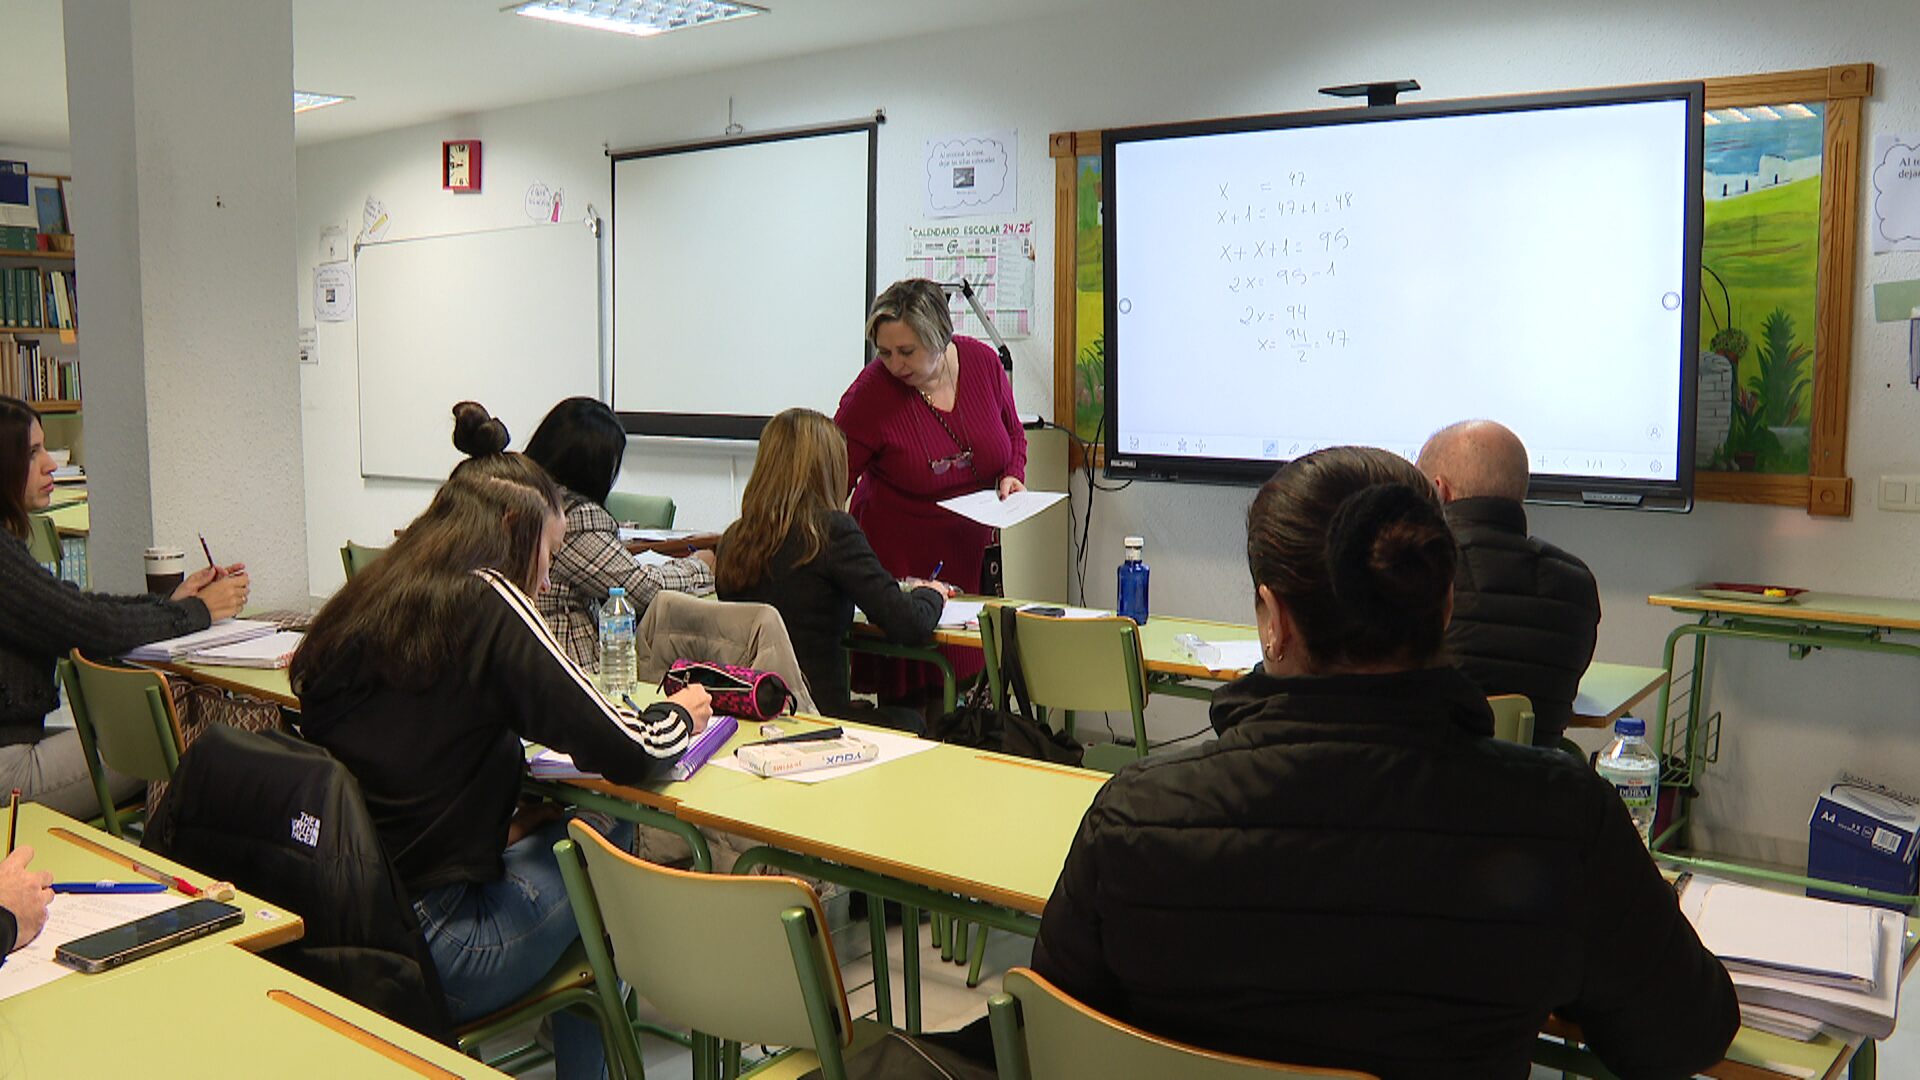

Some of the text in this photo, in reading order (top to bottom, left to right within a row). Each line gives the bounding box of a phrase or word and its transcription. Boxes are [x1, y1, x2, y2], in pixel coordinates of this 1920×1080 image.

[1899, 157, 1911, 167] Al
[1289, 171, 1306, 187] 47
[912, 222, 1031, 238] CALENDARIO ESCOLAR 24/25
[1820, 810, 1837, 824] A4
